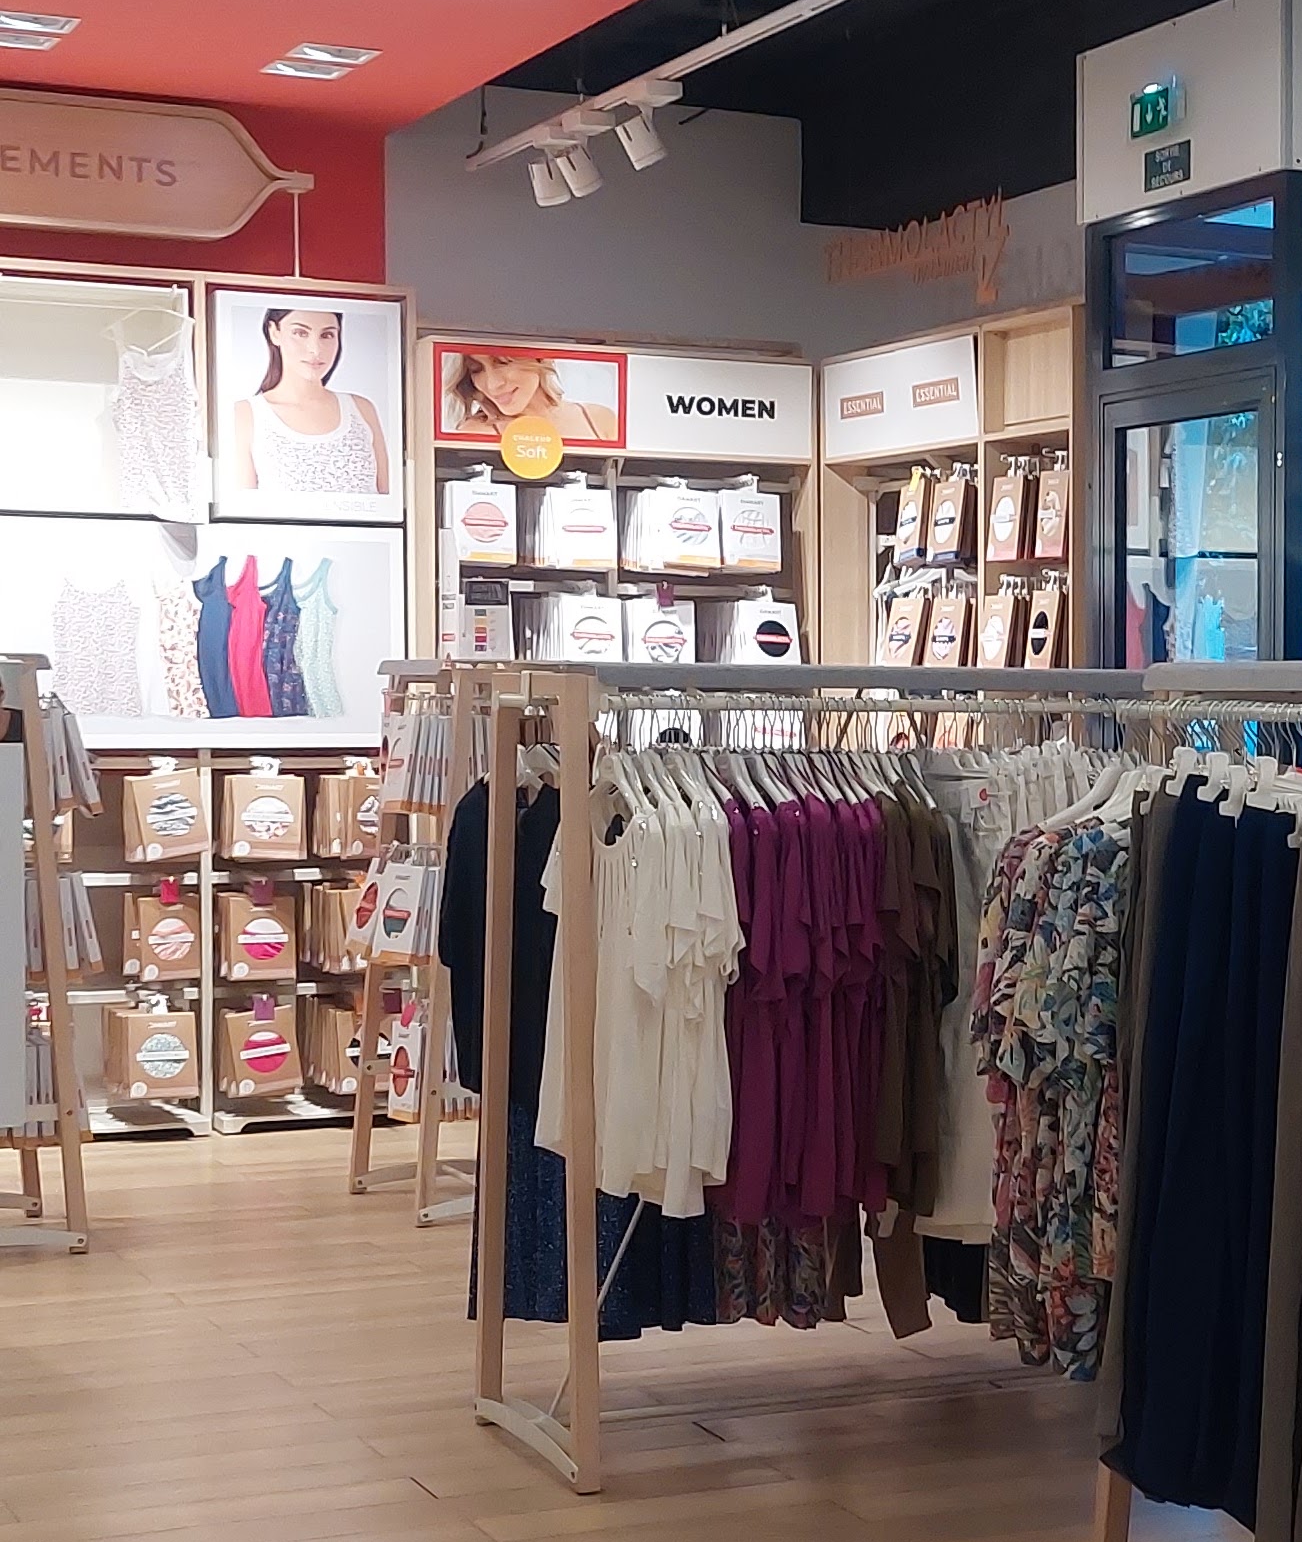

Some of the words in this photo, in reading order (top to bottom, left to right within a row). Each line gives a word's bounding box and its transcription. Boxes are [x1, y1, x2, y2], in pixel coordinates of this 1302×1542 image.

[0, 144, 177, 187] EMENTS
[915, 382, 957, 403] ESSENTIAL
[665, 394, 776, 420] WOMEN
[843, 396, 882, 415] ESSENTIAL
